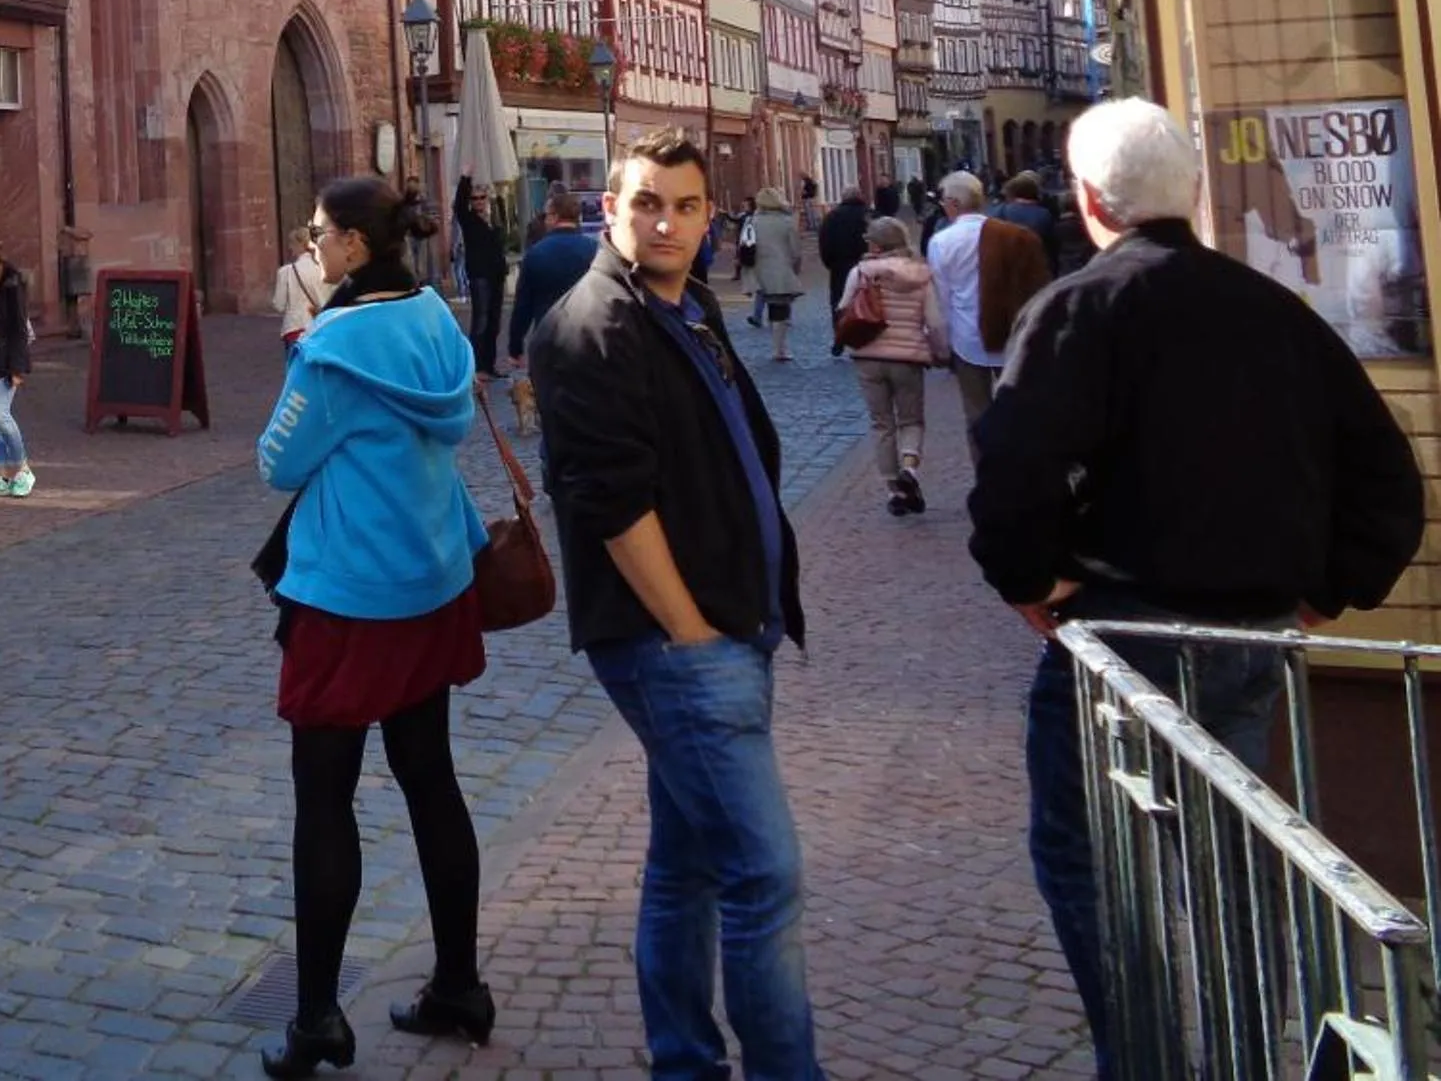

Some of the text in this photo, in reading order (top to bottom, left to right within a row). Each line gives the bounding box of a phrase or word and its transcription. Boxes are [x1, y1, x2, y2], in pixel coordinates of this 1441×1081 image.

[1220, 117, 1266, 164] JO
[1314, 160, 1377, 185] BLOOD
[1299, 184, 1393, 210] ON SNOW
